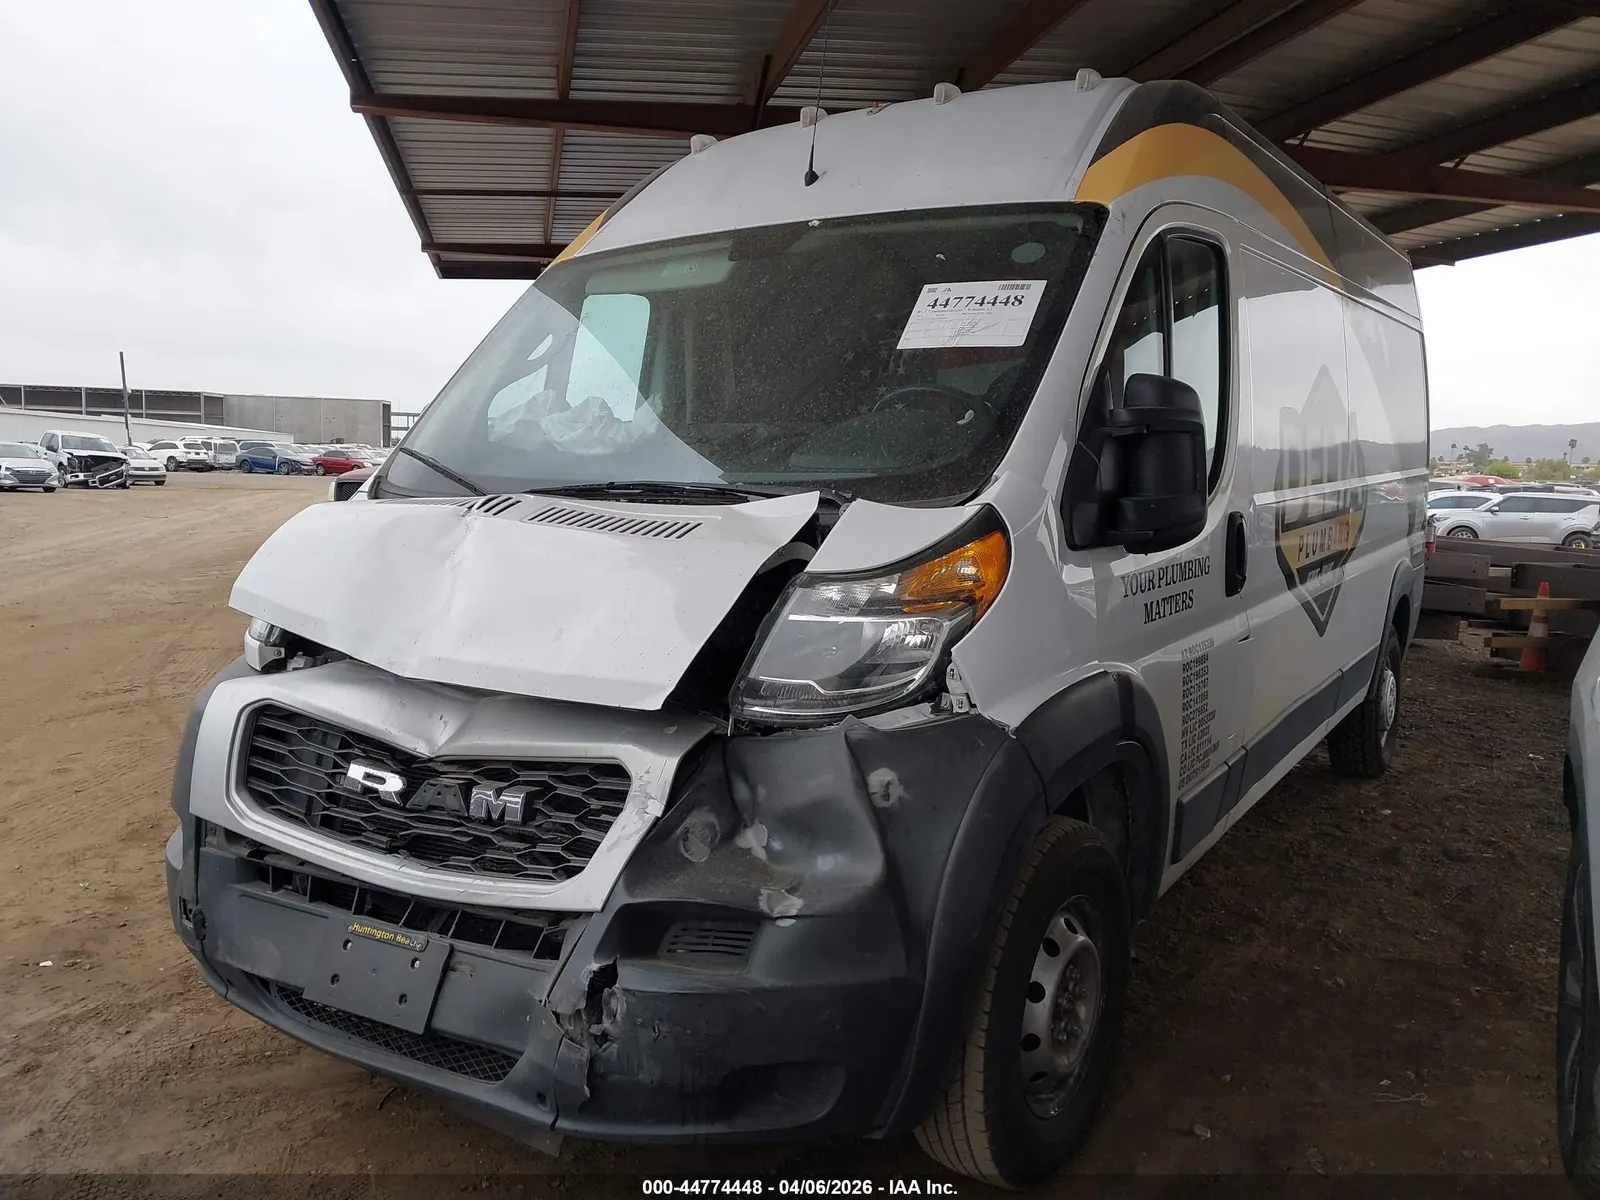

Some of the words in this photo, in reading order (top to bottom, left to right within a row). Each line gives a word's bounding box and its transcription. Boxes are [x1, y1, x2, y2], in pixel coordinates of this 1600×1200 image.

[927, 294, 1025, 310] 44774448
[1297, 520, 1350, 562] PLUMBING
[1120, 569, 1156, 598] YOUR
[1157, 555, 1211, 589] PLUMBING
[1143, 588, 1194, 625] MATTERS
[343, 758, 525, 824] RAM
[352, 922, 395, 941] Huntington
